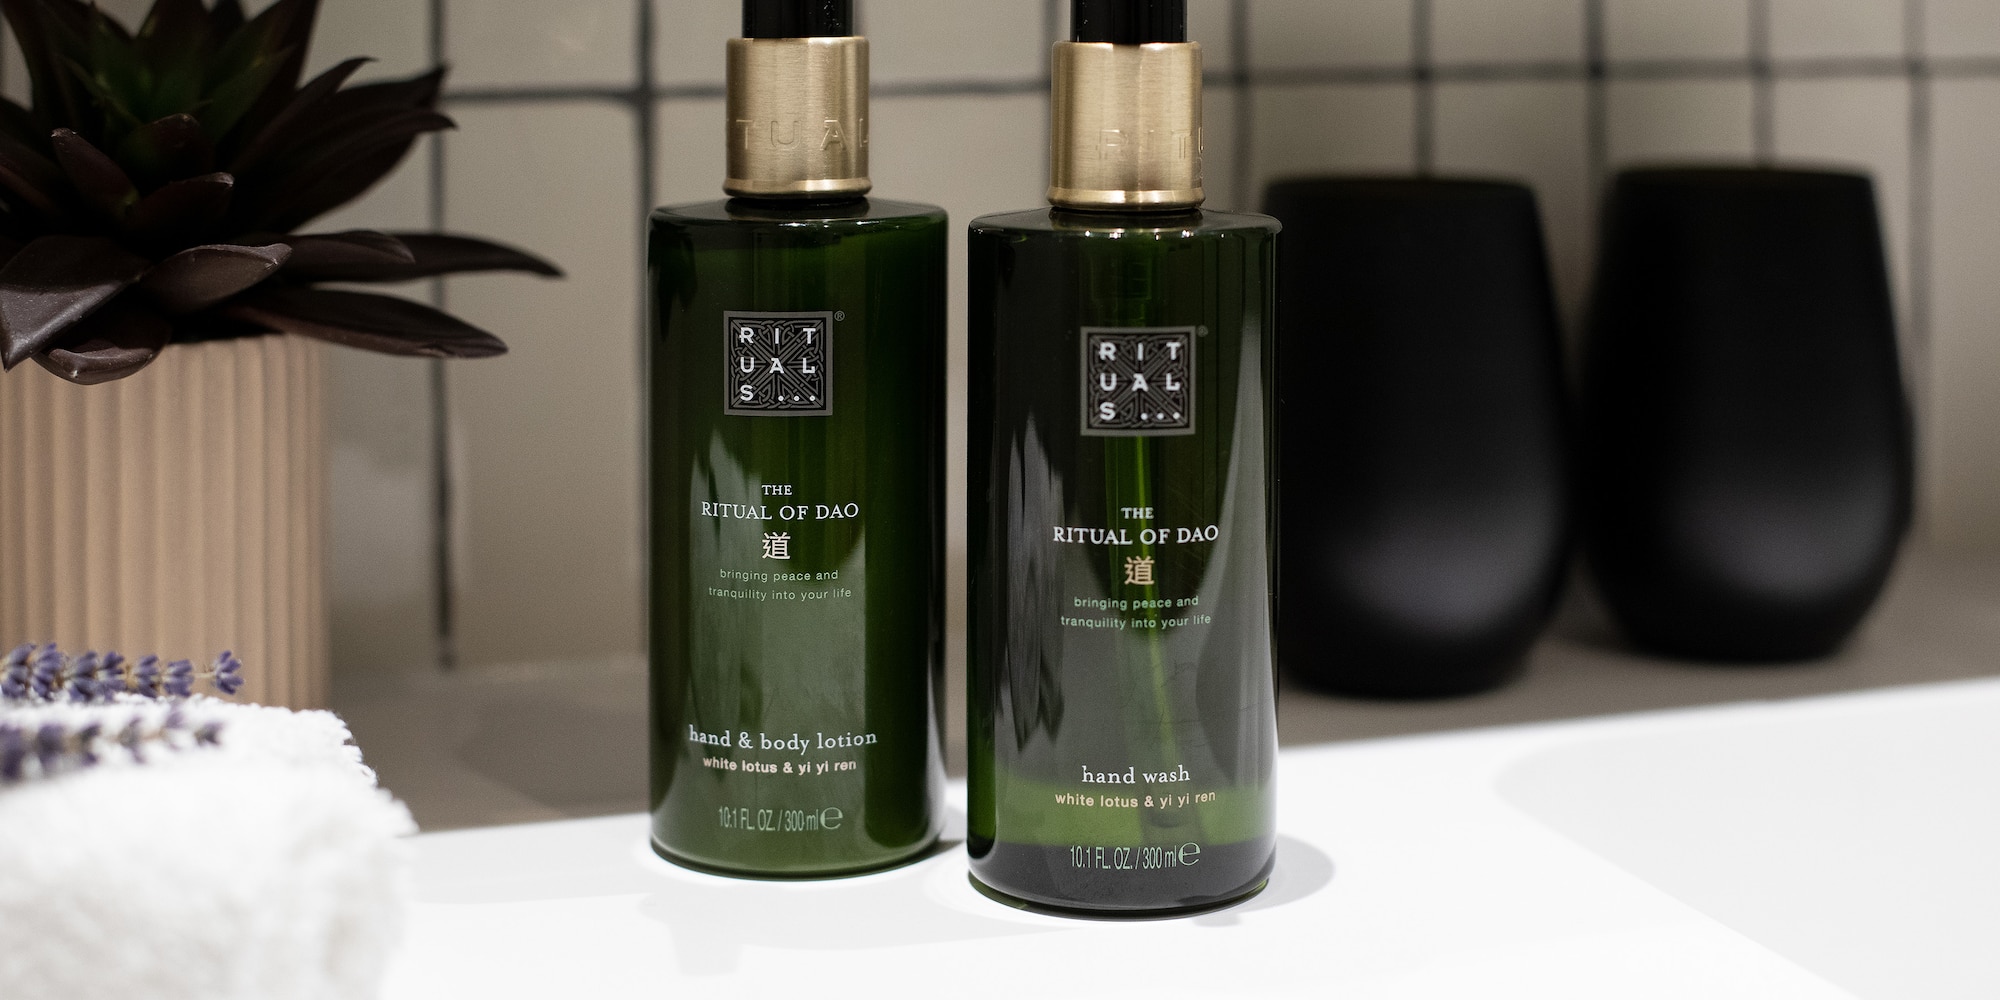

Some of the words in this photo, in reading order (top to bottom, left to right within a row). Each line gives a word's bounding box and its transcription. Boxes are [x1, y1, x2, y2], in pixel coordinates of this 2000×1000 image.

[761, 484, 793, 496] THE
[701, 501, 773, 520] RITUAL
[779, 505, 809, 520] OF
[815, 503, 859, 519] DAO
[1121, 507, 1154, 519] THE
[1053, 526, 1133, 545] RITUAL
[1139, 529, 1170, 545] OF
[1176, 525, 1219, 543] DAO
[761, 531, 791, 560] 道
[720, 568, 768, 583] bringing
[773, 571, 811, 583] peace
[816, 569, 839, 580] and
[1124, 556, 1155, 585] 道
[708, 586, 767, 602] tranquility
[772, 589, 796, 600] into
[801, 590, 828, 601] your
[833, 587, 852, 599] life
[1074, 596, 1128, 611] bringing
[1133, 598, 1172, 610] peace
[1176, 596, 1199, 607] and
[1061, 615, 1126, 631] tranquility
[1131, 617, 1157, 629] into
[1161, 619, 1189, 631] your
[1193, 615, 1212, 626] life
[689, 724, 732, 747] hand
[738, 731, 754, 750] &
[760, 733, 811, 755] body
[816, 731, 878, 749] lotion
[703, 756, 738, 771] white
[741, 760, 778, 774] lotus
[783, 761, 793, 774] &
[798, 761, 811, 776] yi
[816, 760, 829, 776] yi
[834, 759, 857, 771] ren
[1082, 765, 1136, 784] hand
[1142, 765, 1190, 783] wash
[1055, 792, 1094, 806] white
[1100, 795, 1138, 808] lotus
[1144, 796, 1154, 808] &
[1160, 796, 1172, 809] yi
[1178, 793, 1190, 808] yi
[1195, 791, 1216, 803] ren
[718, 806, 738, 828] 10.1
[785, 810, 806, 832] 300
[1070, 845, 1092, 868] 10.1
[1095, 847, 1111, 869] FL.
[1114, 848, 1133, 870] OZ.
[1142, 847, 1163, 869] 300
[1164, 846, 1177, 867] ml
